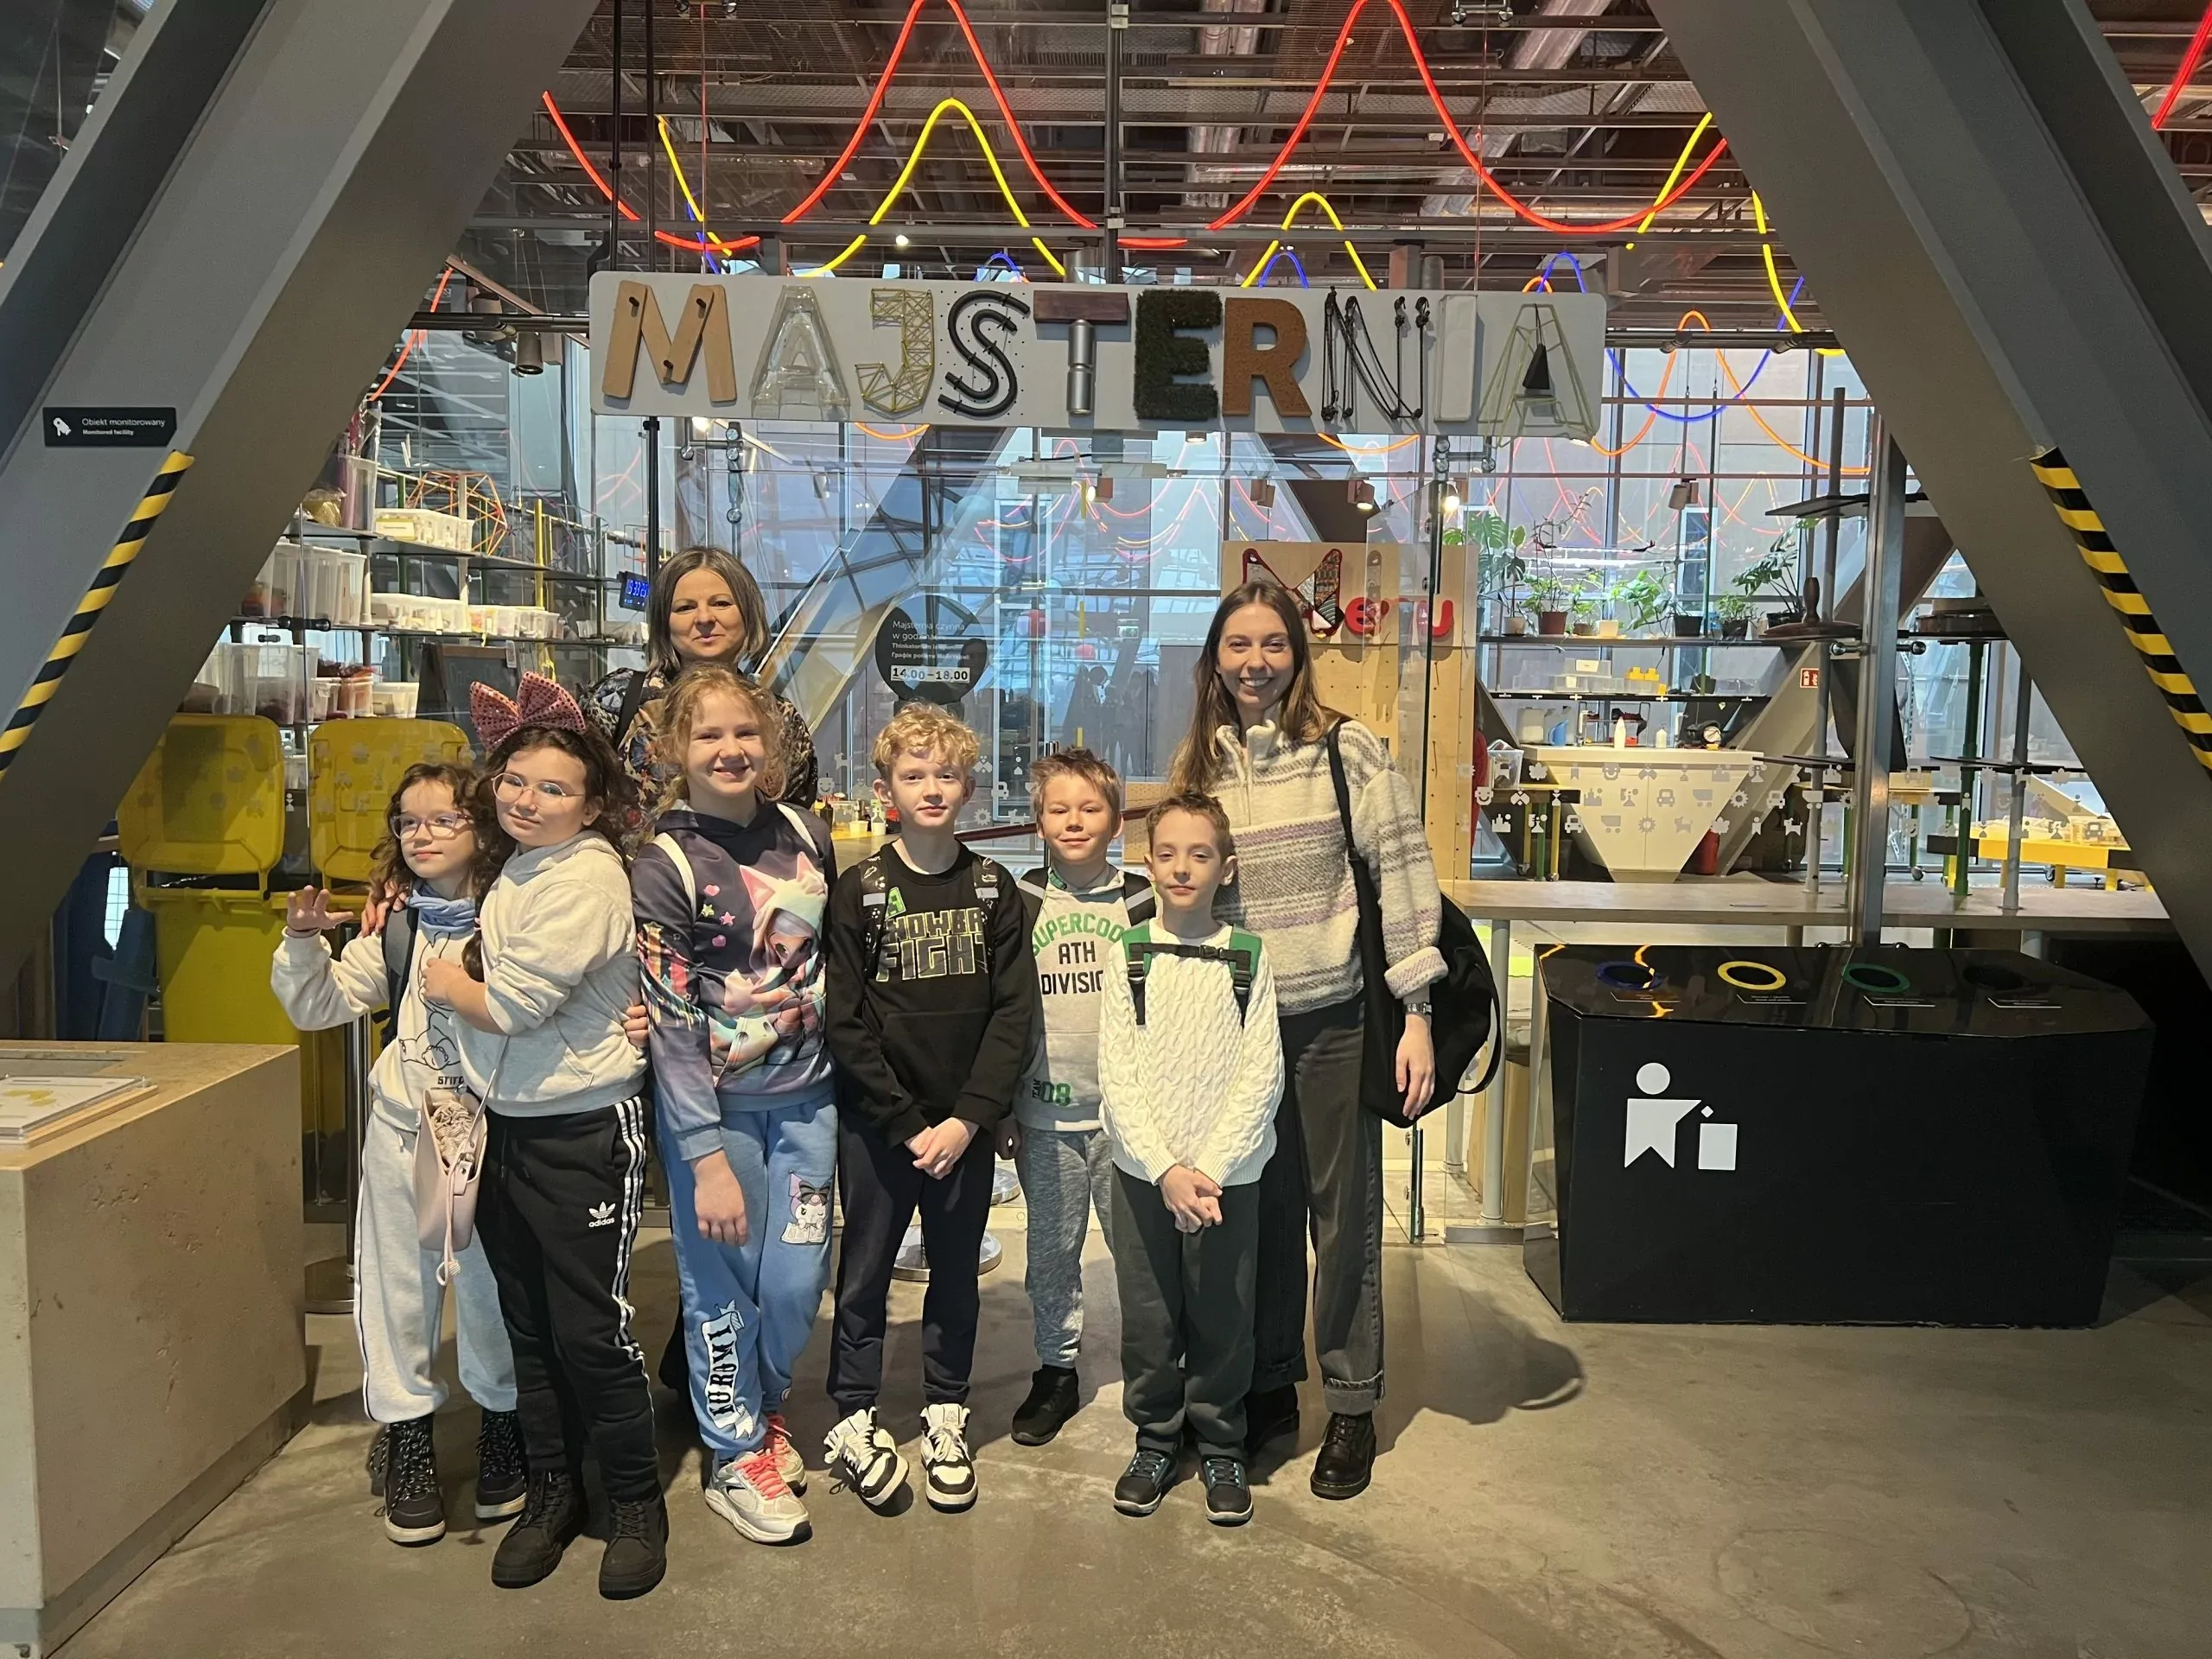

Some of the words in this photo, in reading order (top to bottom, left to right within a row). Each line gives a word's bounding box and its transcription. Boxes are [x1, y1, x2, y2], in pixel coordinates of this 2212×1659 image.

[601, 280, 1596, 442] MAJSTERNIA
[81, 417, 108, 426] Obiekt
[109, 417, 166, 428] monitorowany
[884, 907, 983, 942] NOWBA
[1033, 912, 1125, 957] SUPERCOO
[1058, 940, 1096, 964] ATH
[1040, 969, 1104, 995] DIVISIO
[437, 1076, 465, 1085] STITC
[588, 1217, 615, 1228] adidas
